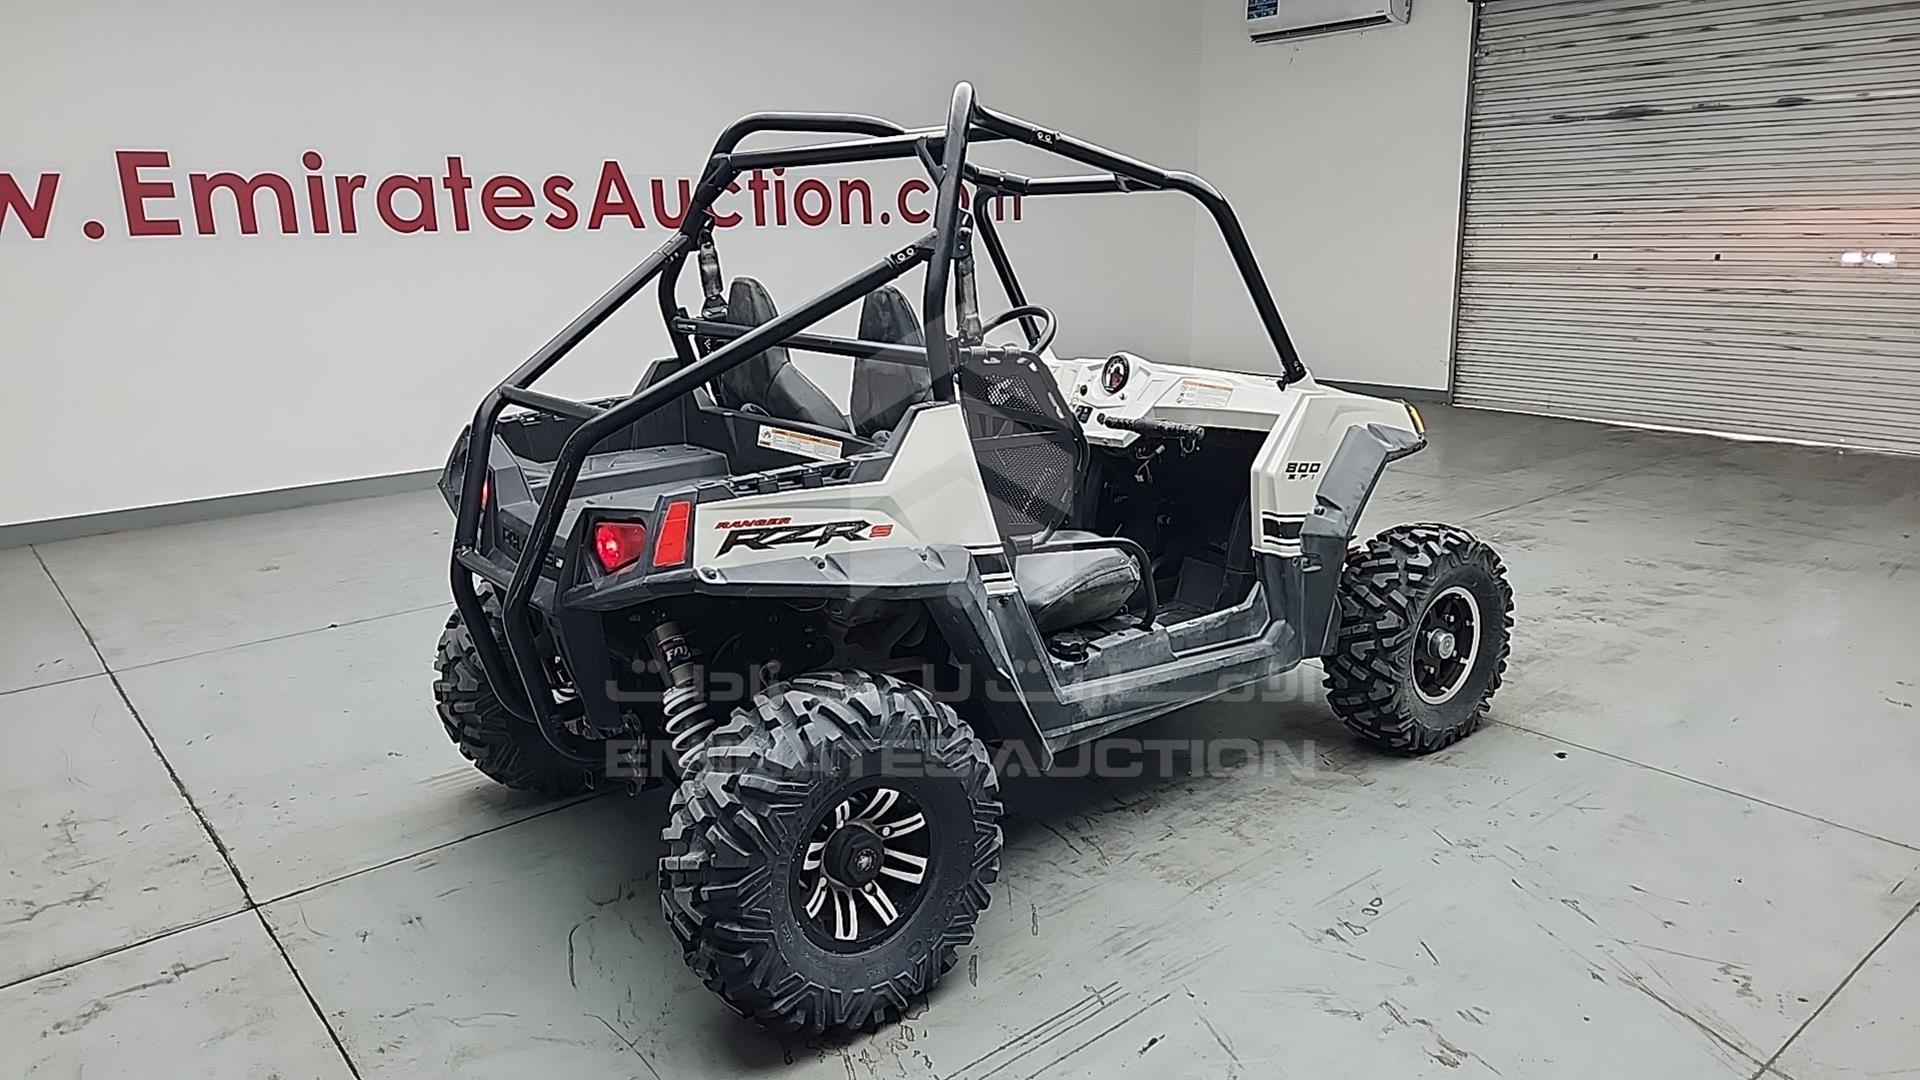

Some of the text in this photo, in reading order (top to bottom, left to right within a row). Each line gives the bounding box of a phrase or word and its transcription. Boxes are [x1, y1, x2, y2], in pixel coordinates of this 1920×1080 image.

[1285, 462, 1321, 473] 800
[714, 517, 791, 529] RANGER
[714, 519, 872, 559] RZR
